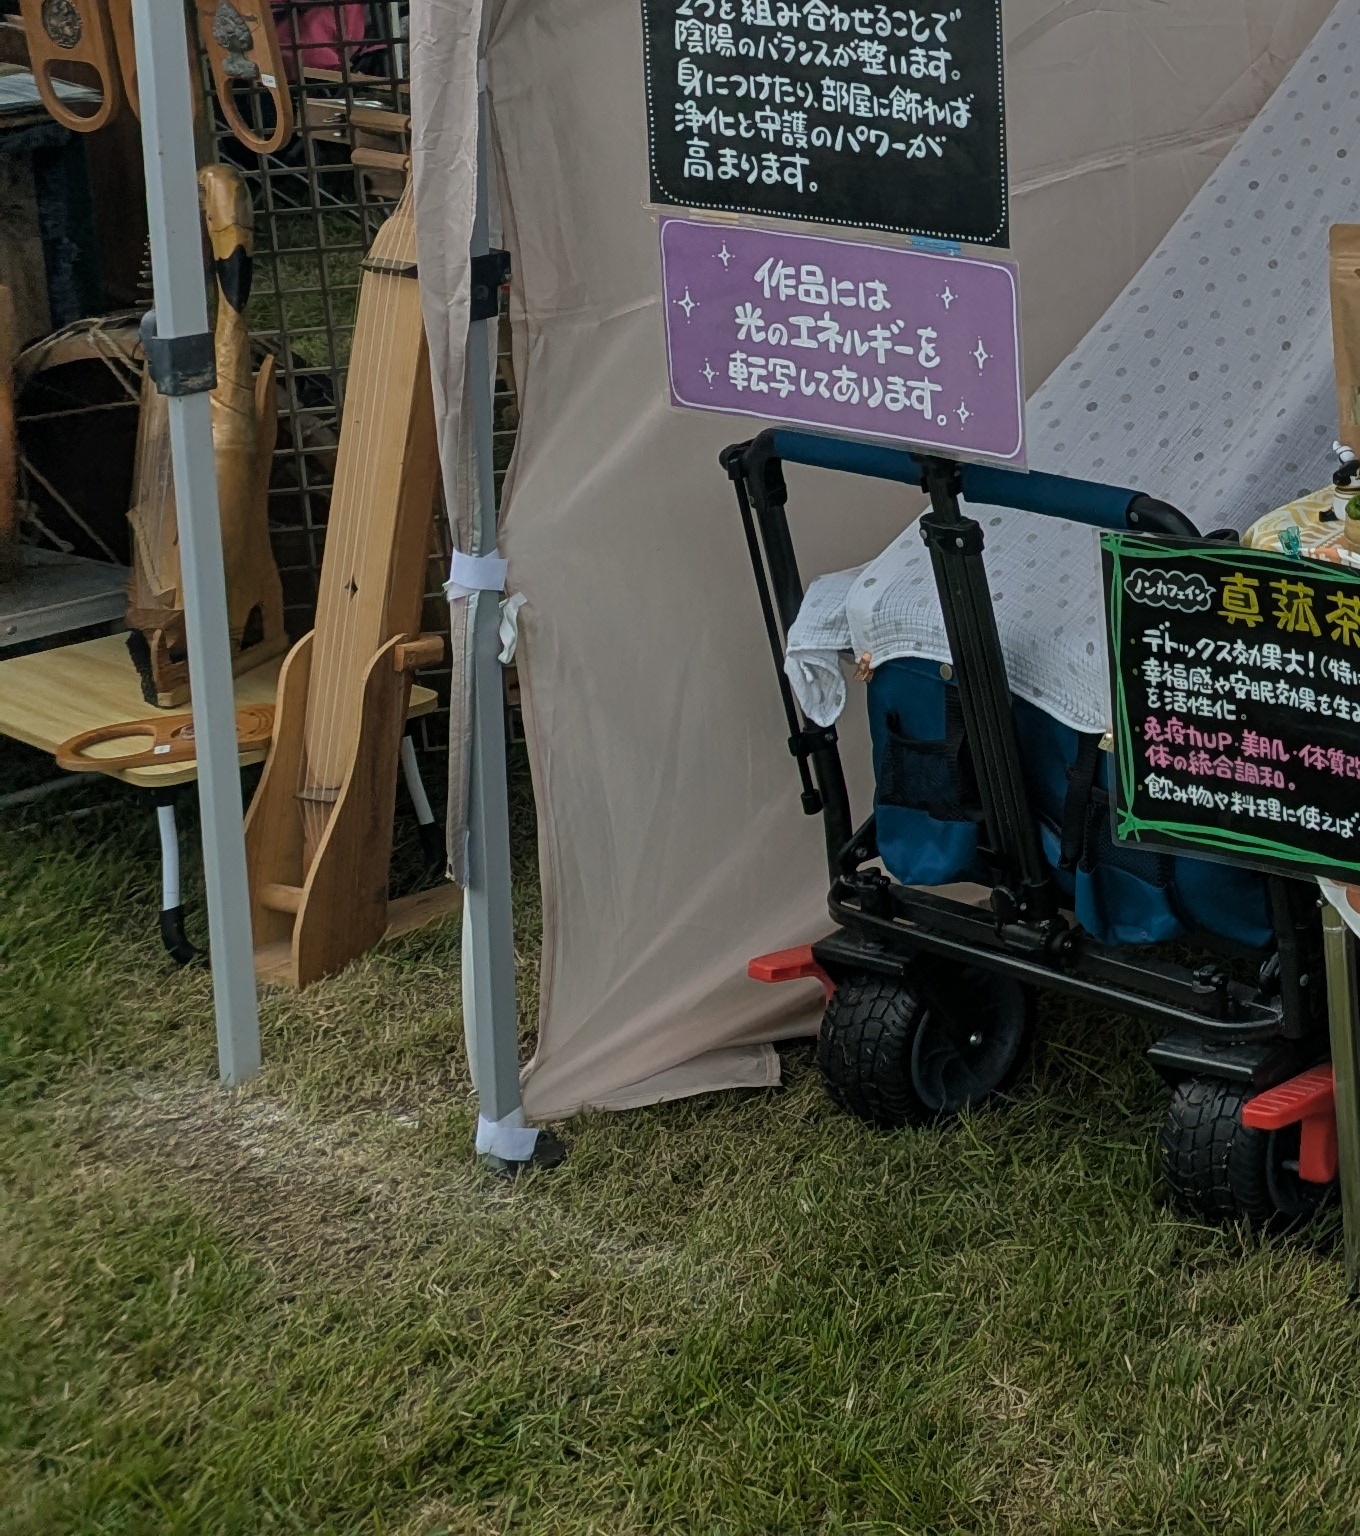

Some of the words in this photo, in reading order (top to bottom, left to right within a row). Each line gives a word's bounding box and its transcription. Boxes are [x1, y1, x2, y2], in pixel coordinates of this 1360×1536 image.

[674, 19, 961, 83] 陰陽のバランスが整います。
[674, 100, 944, 158] 浄化と守護のパワーが
[683, 140, 819, 194] 高まります。
[753, 256, 891, 311] 作品には
[734, 302, 941, 368] 光のエネルギーを
[727, 351, 948, 427] 転写してあります。
[1134, 577, 1206, 602] ノンカフェイン
[1145, 685, 1248, 722] を活性化。
[1144, 744, 1296, 791] 体の統合調和。
